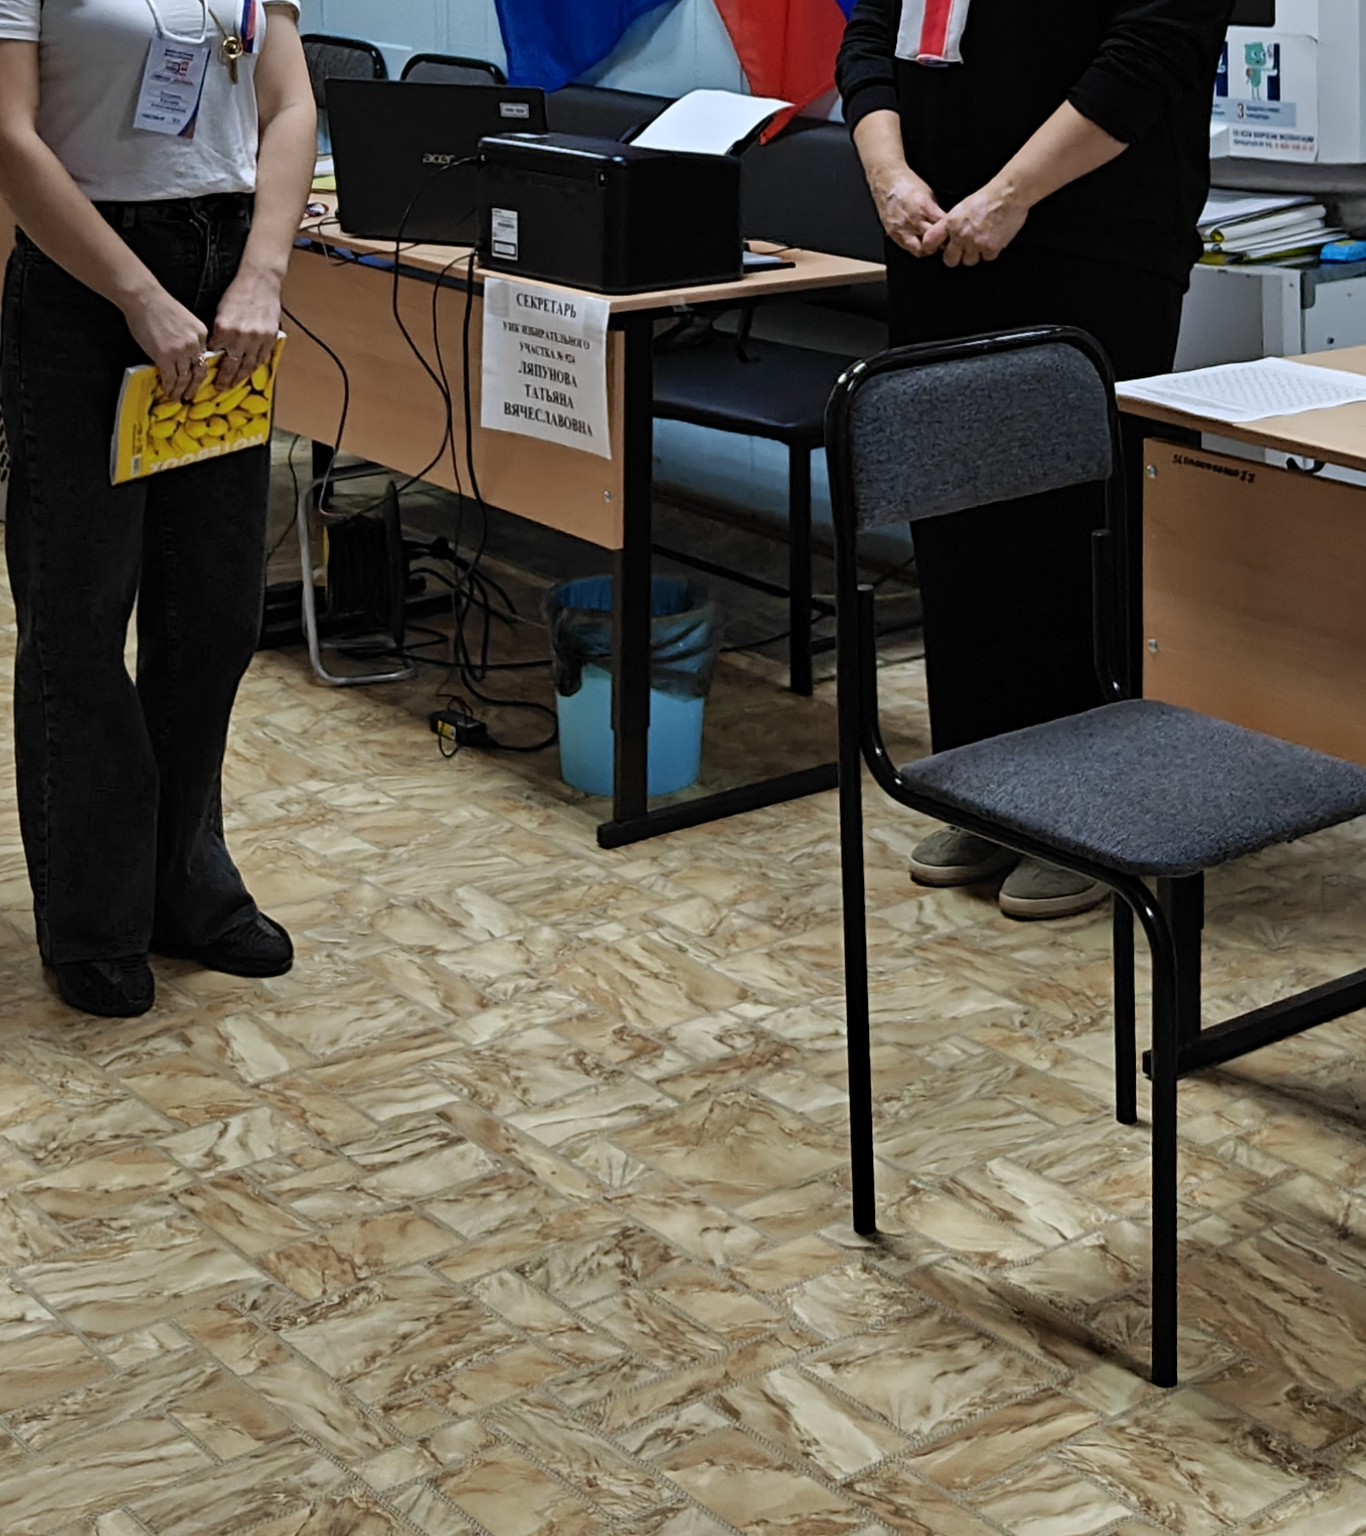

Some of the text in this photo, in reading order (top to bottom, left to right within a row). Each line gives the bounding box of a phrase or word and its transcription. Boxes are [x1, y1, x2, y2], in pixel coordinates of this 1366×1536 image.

[422, 153, 456, 164] acer
[516, 292, 577, 318] СЕКРЕТАРЬ
[503, 321, 590, 350] УИК ИЗБИРАТЕЛЬНОГО
[519, 341, 556, 359] УЧАСТКА
[518, 360, 578, 388] ЛЯПУНОВА
[524, 383, 574, 409] ТАТЬЯНА
[503, 401, 594, 437] ВЯЧЕСЛАВОВНА
